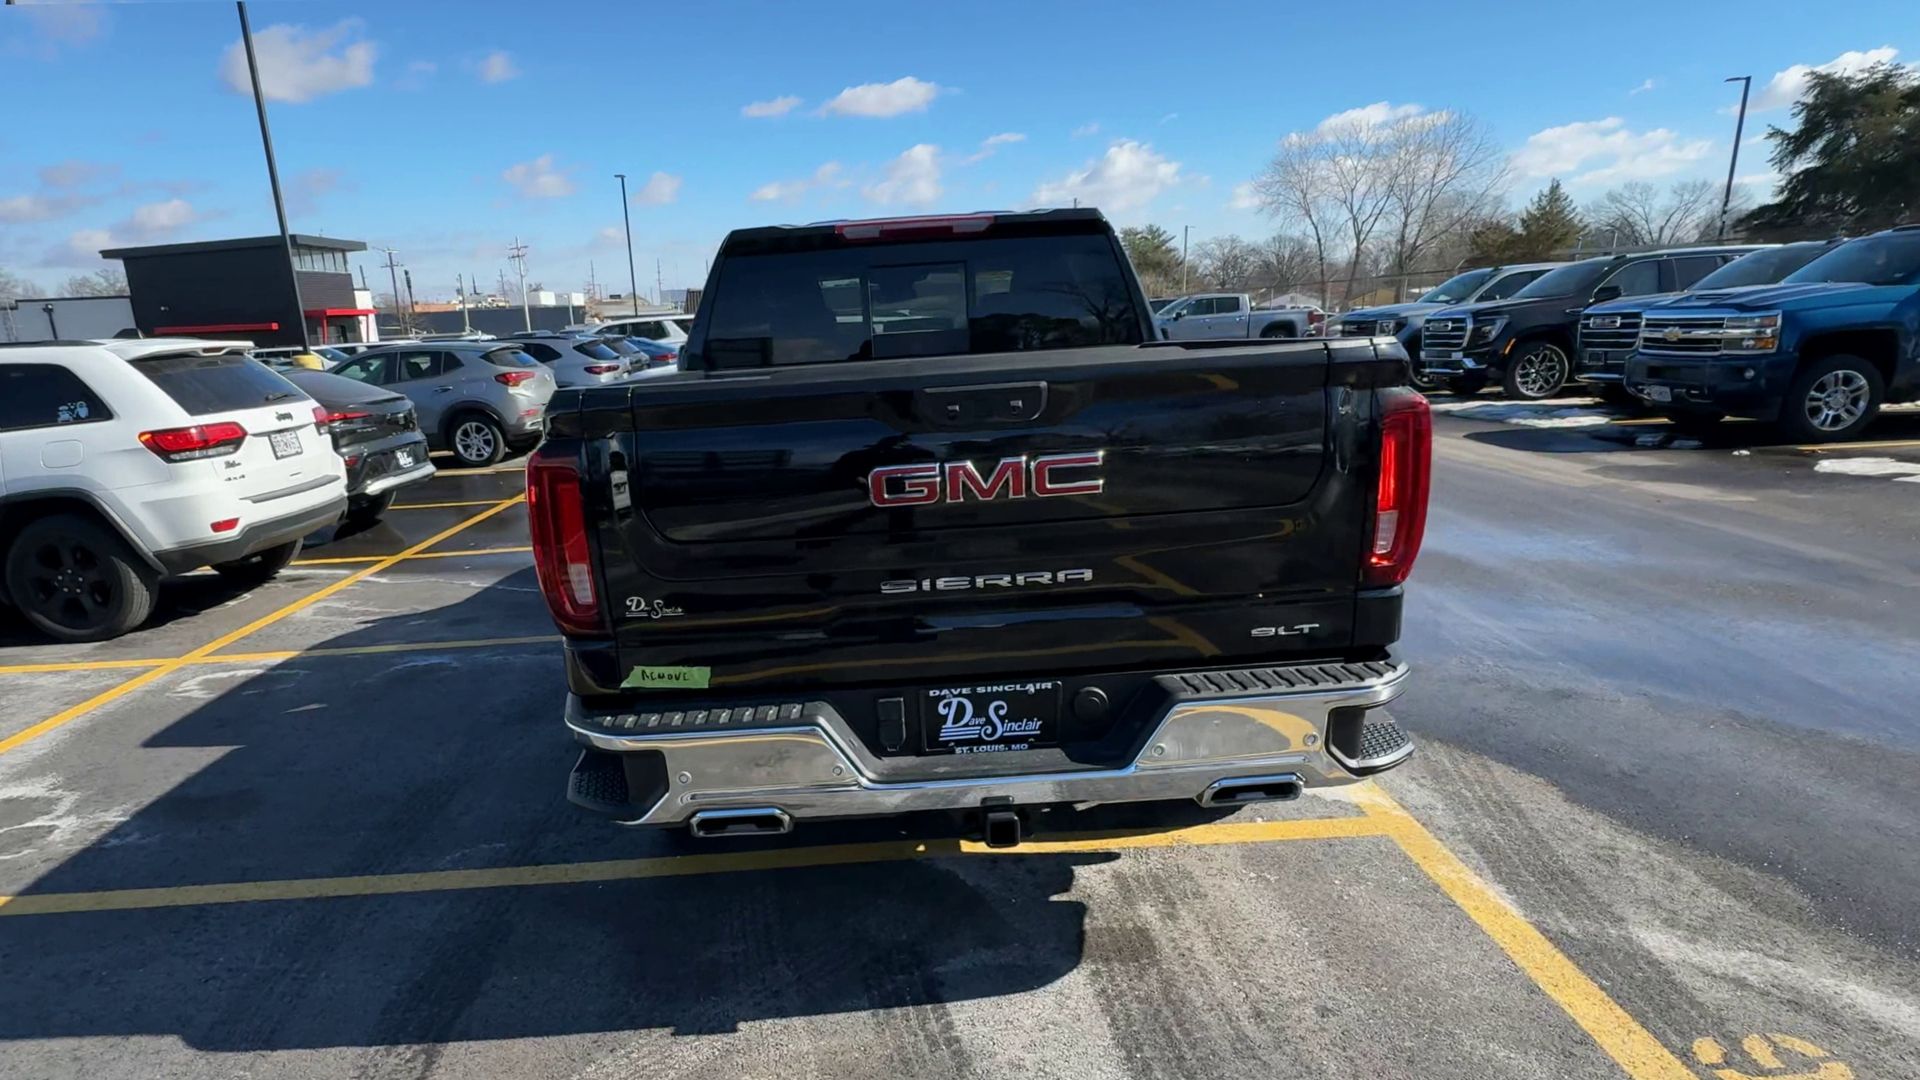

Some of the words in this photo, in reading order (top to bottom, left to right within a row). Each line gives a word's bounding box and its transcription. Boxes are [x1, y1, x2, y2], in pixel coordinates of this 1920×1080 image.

[868, 451, 1105, 507] GMC
[881, 568, 1093, 594] SIERRA
[1251, 623, 1319, 637] SLT
[641, 669, 689, 681] REMOVE
[929, 687, 972, 697] DAVE
[976, 682, 1052, 694] SINCLAIR
[938, 697, 986, 728] Dave
[981, 700, 1042, 741] Sinclair
[1011, 743, 1028, 751] MO
